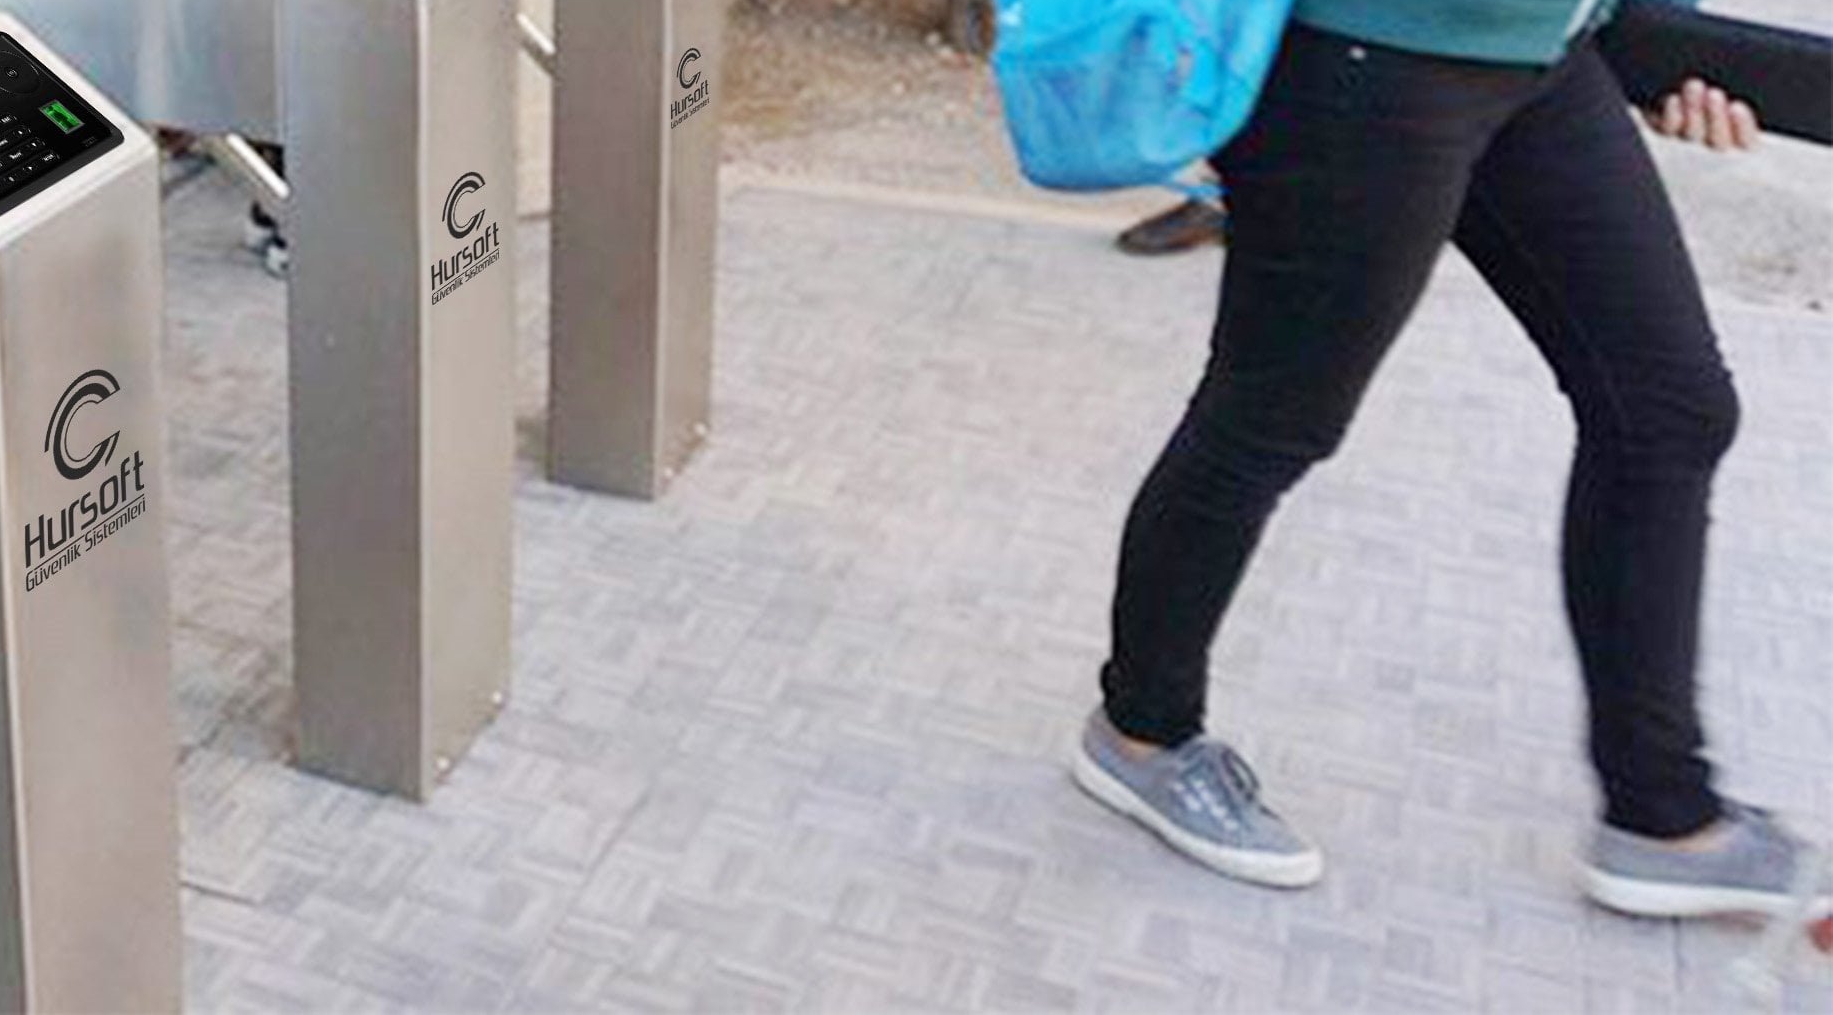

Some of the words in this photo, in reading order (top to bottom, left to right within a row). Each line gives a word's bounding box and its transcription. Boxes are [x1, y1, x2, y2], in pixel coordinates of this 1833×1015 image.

[670, 80, 709, 119] Hursoft
[431, 222, 500, 291] Hursoft
[24, 450, 145, 569] Hursoft
[25, 543, 81, 592] Güvenlik
[84, 497, 146, 553] Sistemleri
